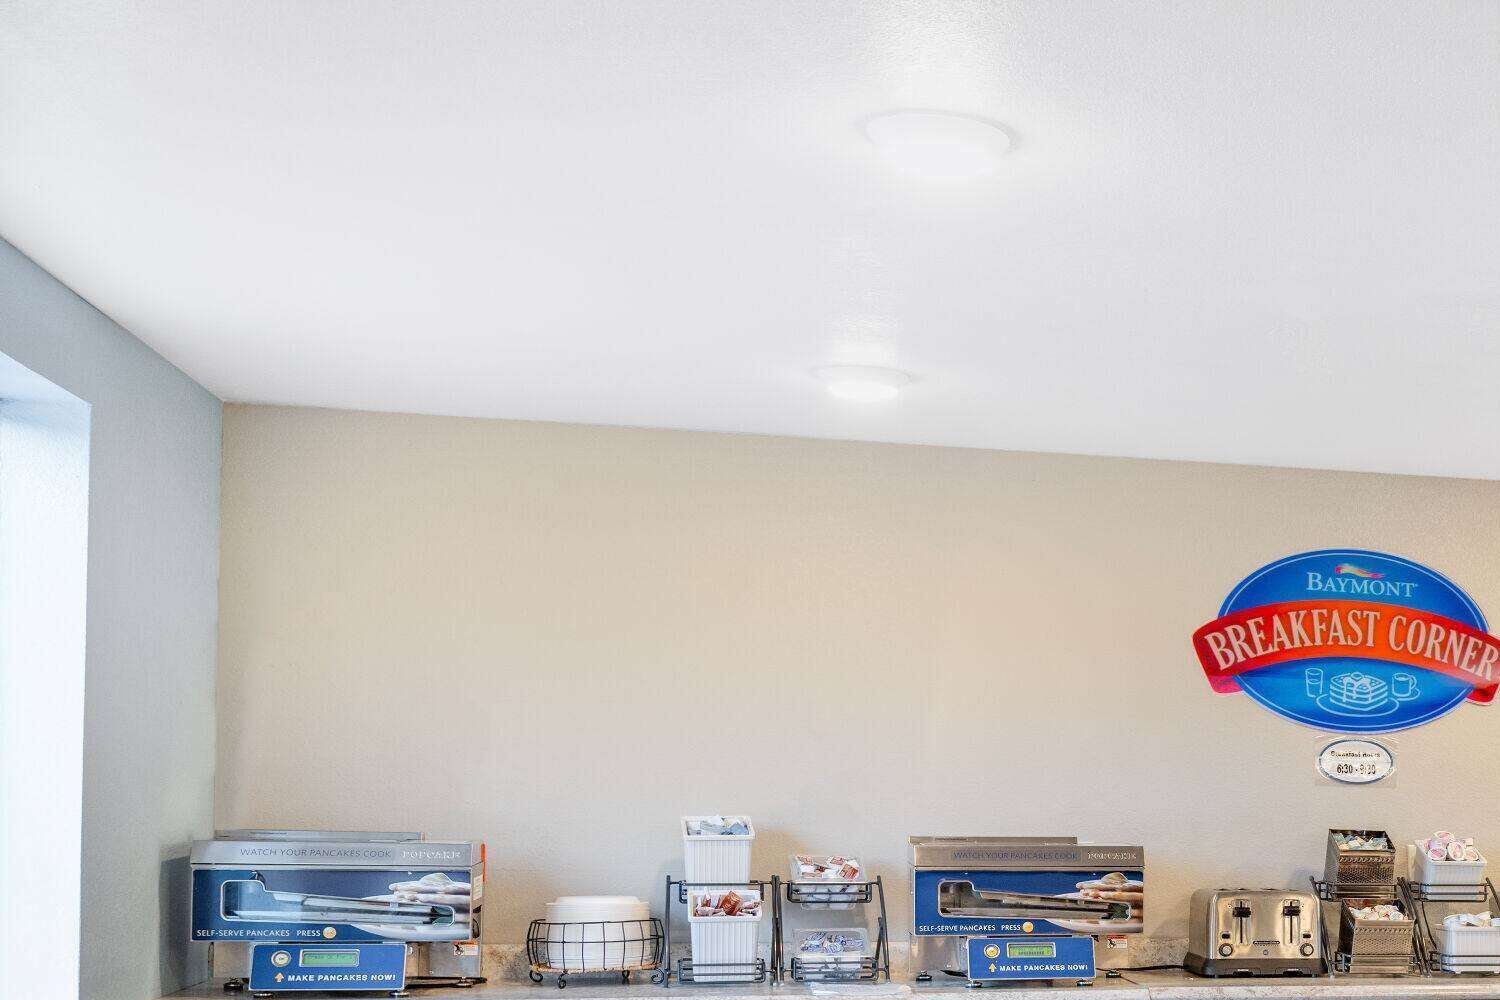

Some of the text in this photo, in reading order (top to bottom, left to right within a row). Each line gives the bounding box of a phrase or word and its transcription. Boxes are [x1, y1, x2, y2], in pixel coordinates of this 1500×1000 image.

[1306, 572, 1416, 598] BAYMONT
[1204, 608, 1500, 681] BREAKFAST CORNER
[1336, 763, 1353, 774] 6:30
[240, 848, 392, 858] WATCH YOUR PANCAKES COOK
[953, 851, 984, 860] WATCH
[985, 851, 1009, 860] YOUR
[1010, 851, 1052, 860] PANCAKES
[196, 929, 290, 937] SELF-SERVE PANCAKES
[296, 929, 321, 937] PRESS
[287, 974, 396, 982] MAKE PANCAKES NOW!
